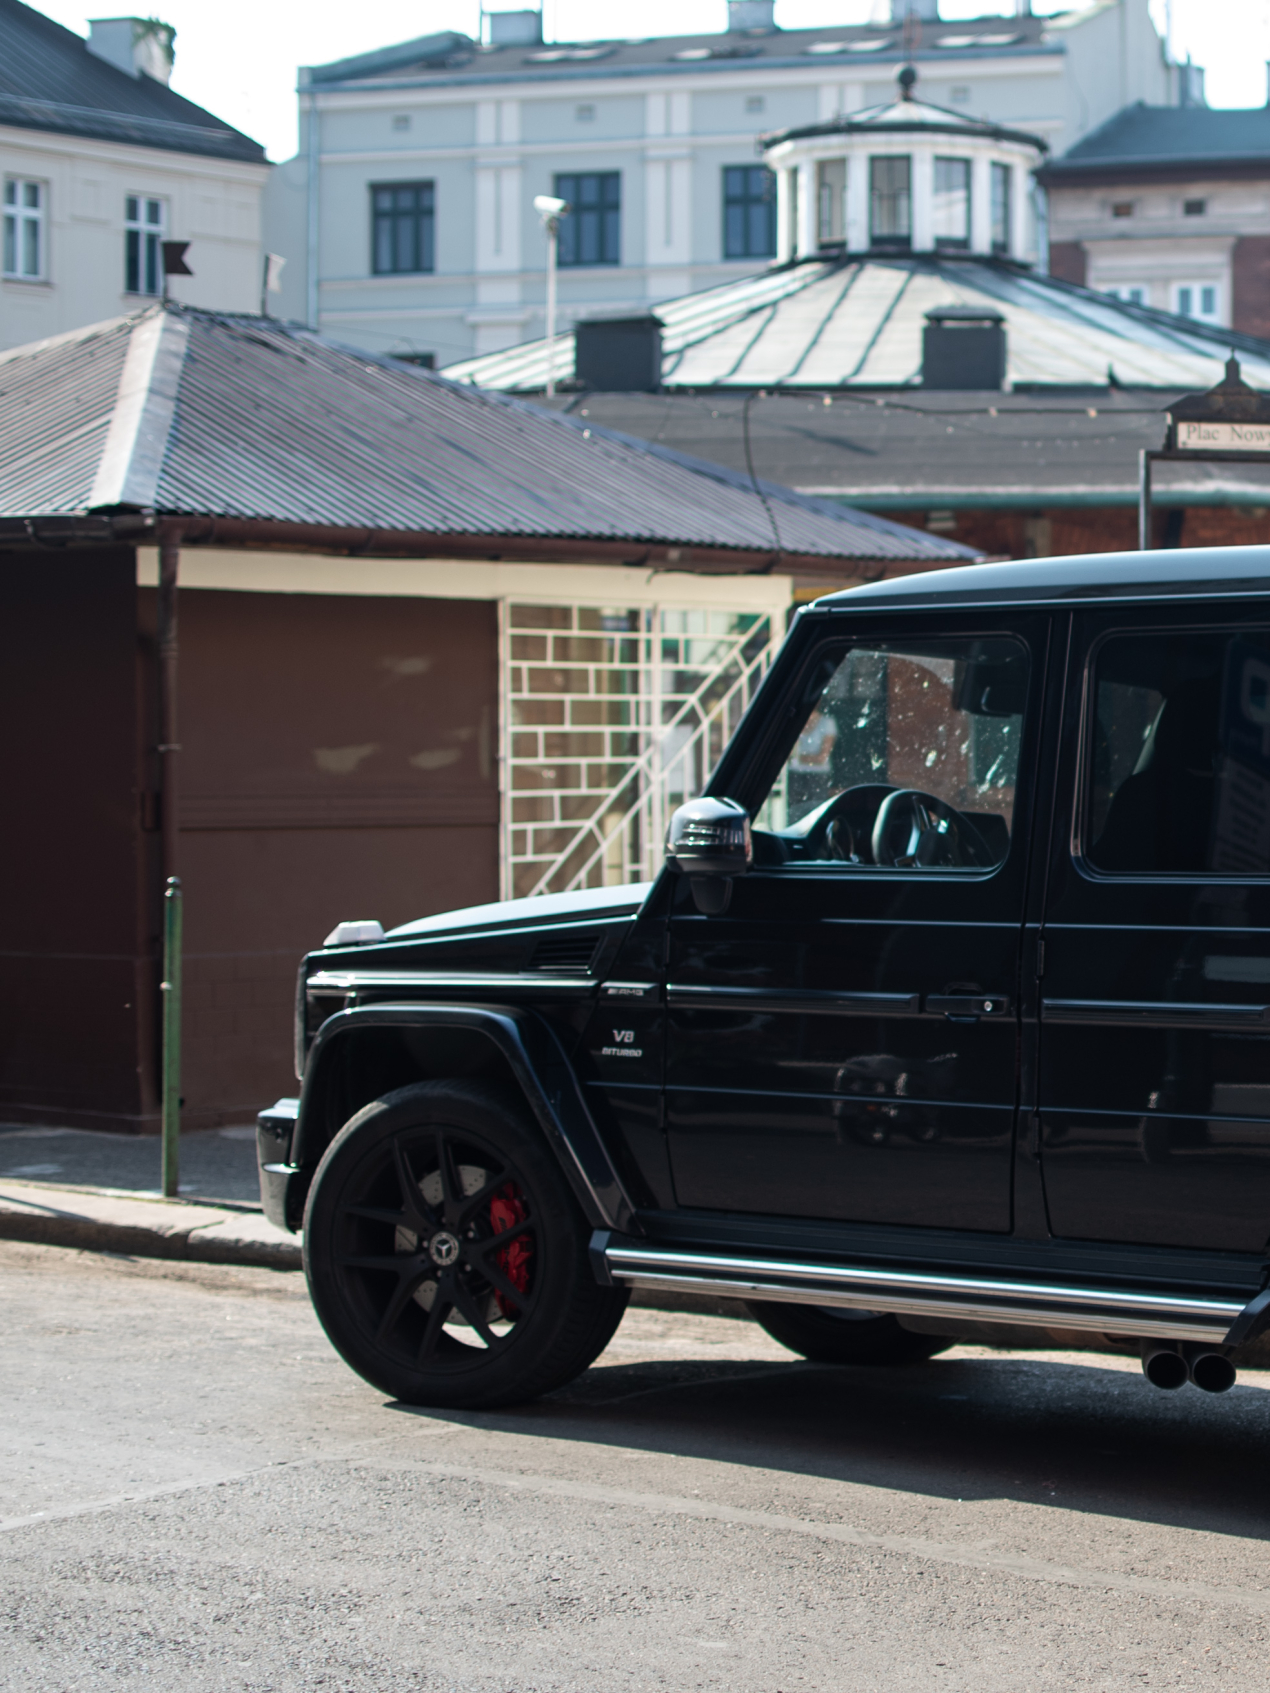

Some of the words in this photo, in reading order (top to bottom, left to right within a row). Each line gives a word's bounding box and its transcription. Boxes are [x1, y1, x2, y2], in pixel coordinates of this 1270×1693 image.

[1185, 423, 1220, 441] Plac
[616, 988, 645, 997] AMG
[612, 1029, 635, 1043] V8
[601, 1046, 643, 1058] BITURBO
